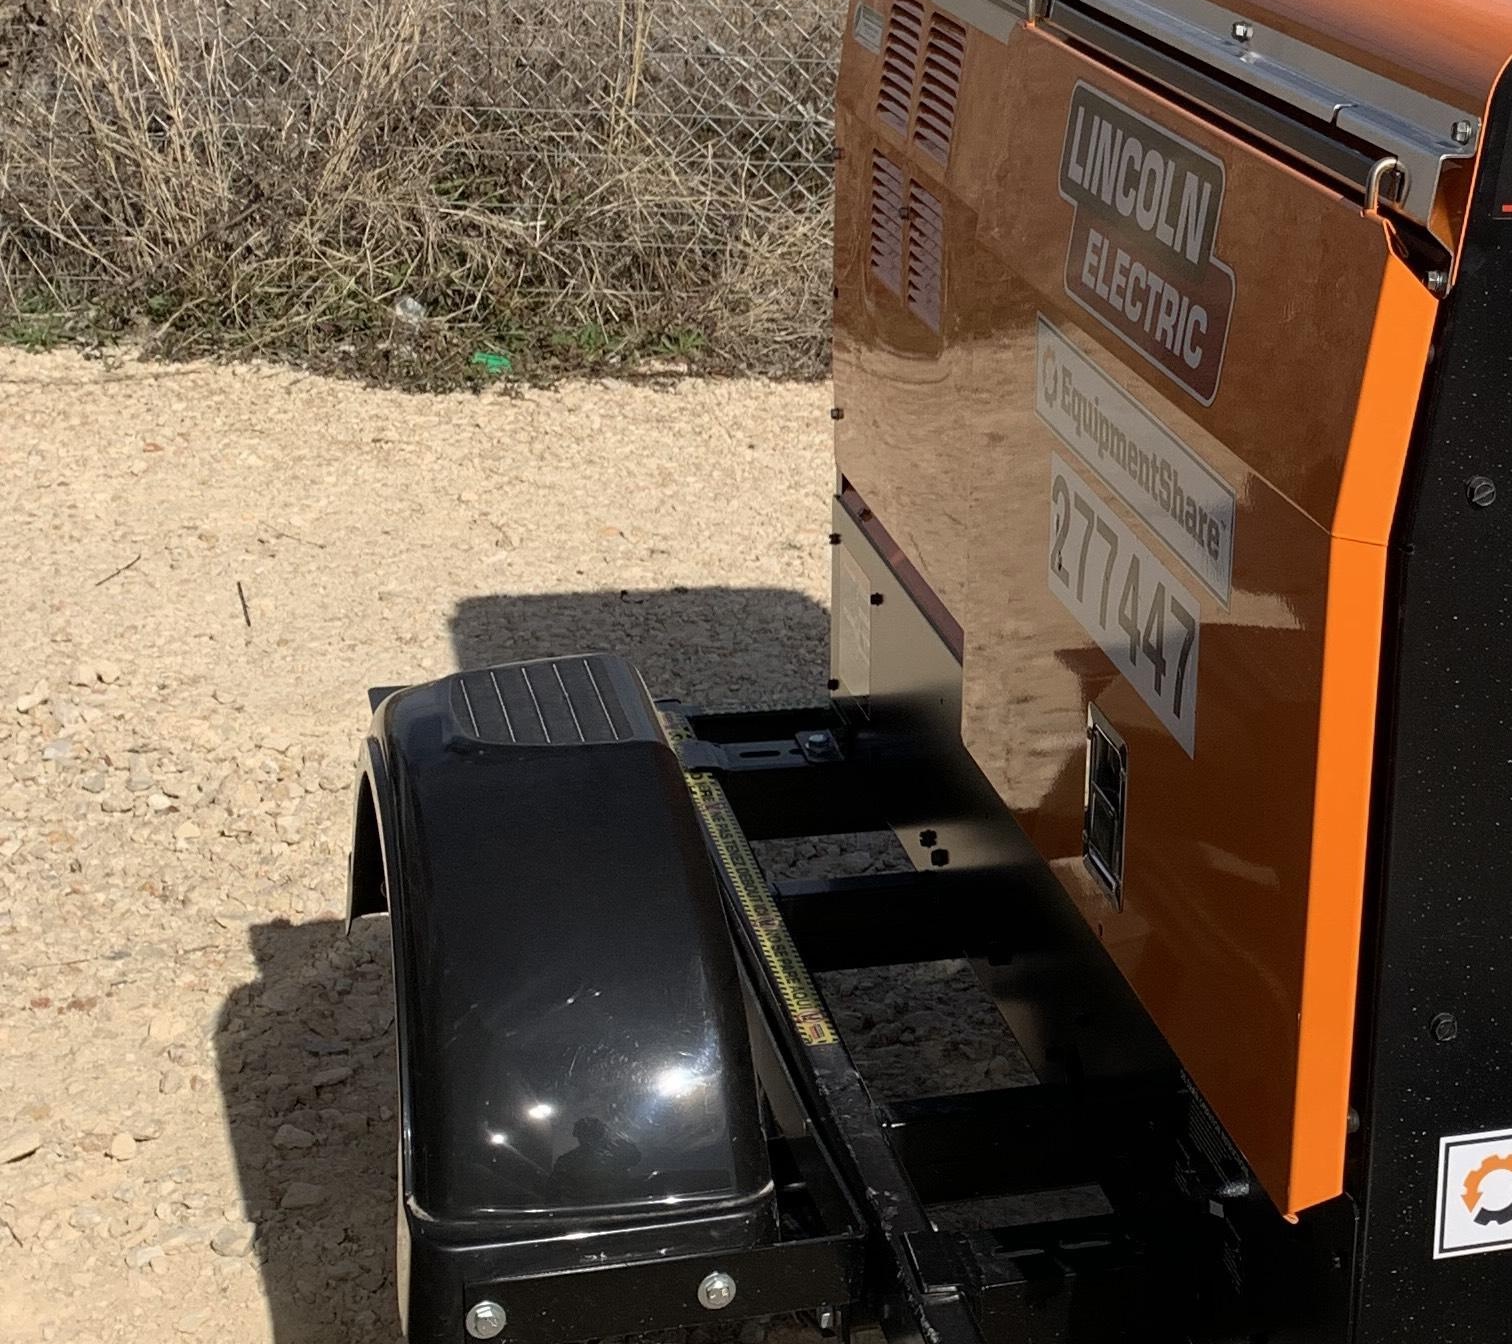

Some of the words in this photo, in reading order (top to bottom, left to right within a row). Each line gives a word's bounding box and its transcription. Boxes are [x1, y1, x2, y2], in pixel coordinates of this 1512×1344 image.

[1069, 105, 1212, 265] LINCOLN
[1082, 228, 1208, 371] ELECTRIC
[1060, 365, 1221, 559] EquipmentShare
[1051, 474, 1196, 721] 277447
[715, 824, 730, 838] PAS
[721, 838, 743, 865] TENEZ
[763, 928, 780, 942] NO
[776, 958, 800, 984] PARE
